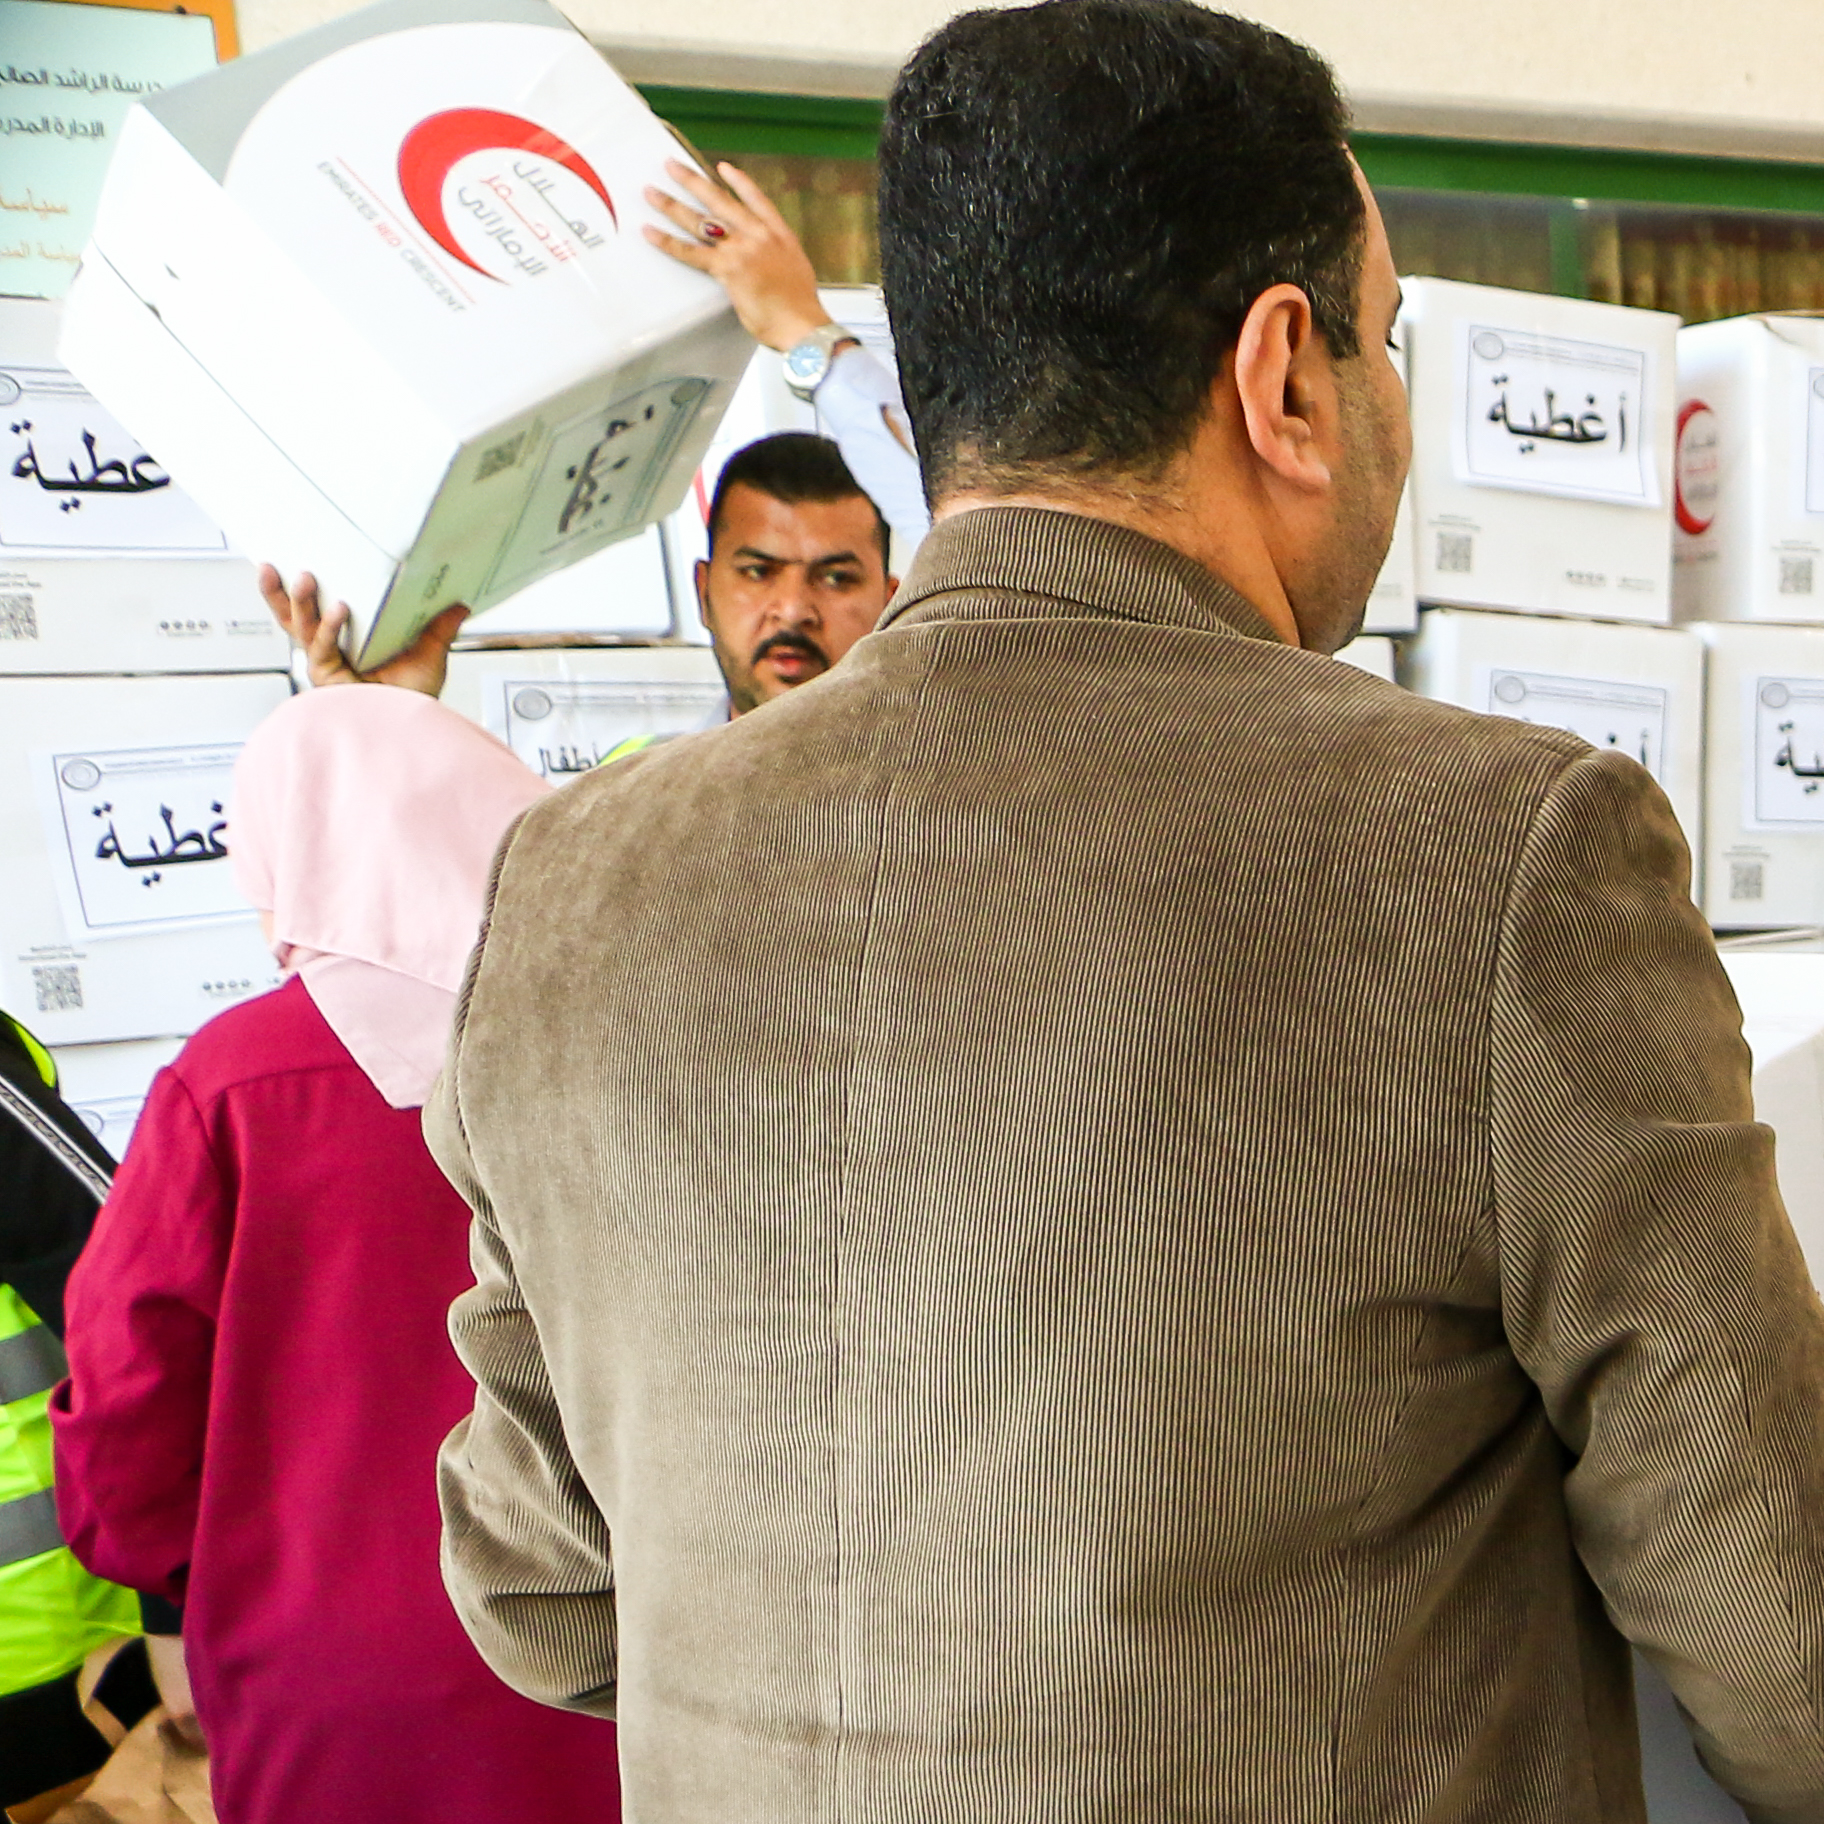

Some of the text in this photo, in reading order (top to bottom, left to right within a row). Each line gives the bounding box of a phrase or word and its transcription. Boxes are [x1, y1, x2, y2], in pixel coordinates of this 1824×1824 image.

[0, 65, 49, 85] الصال
[1486, 366, 1627, 454] أغطية
[91, 800, 229, 888] غطية
